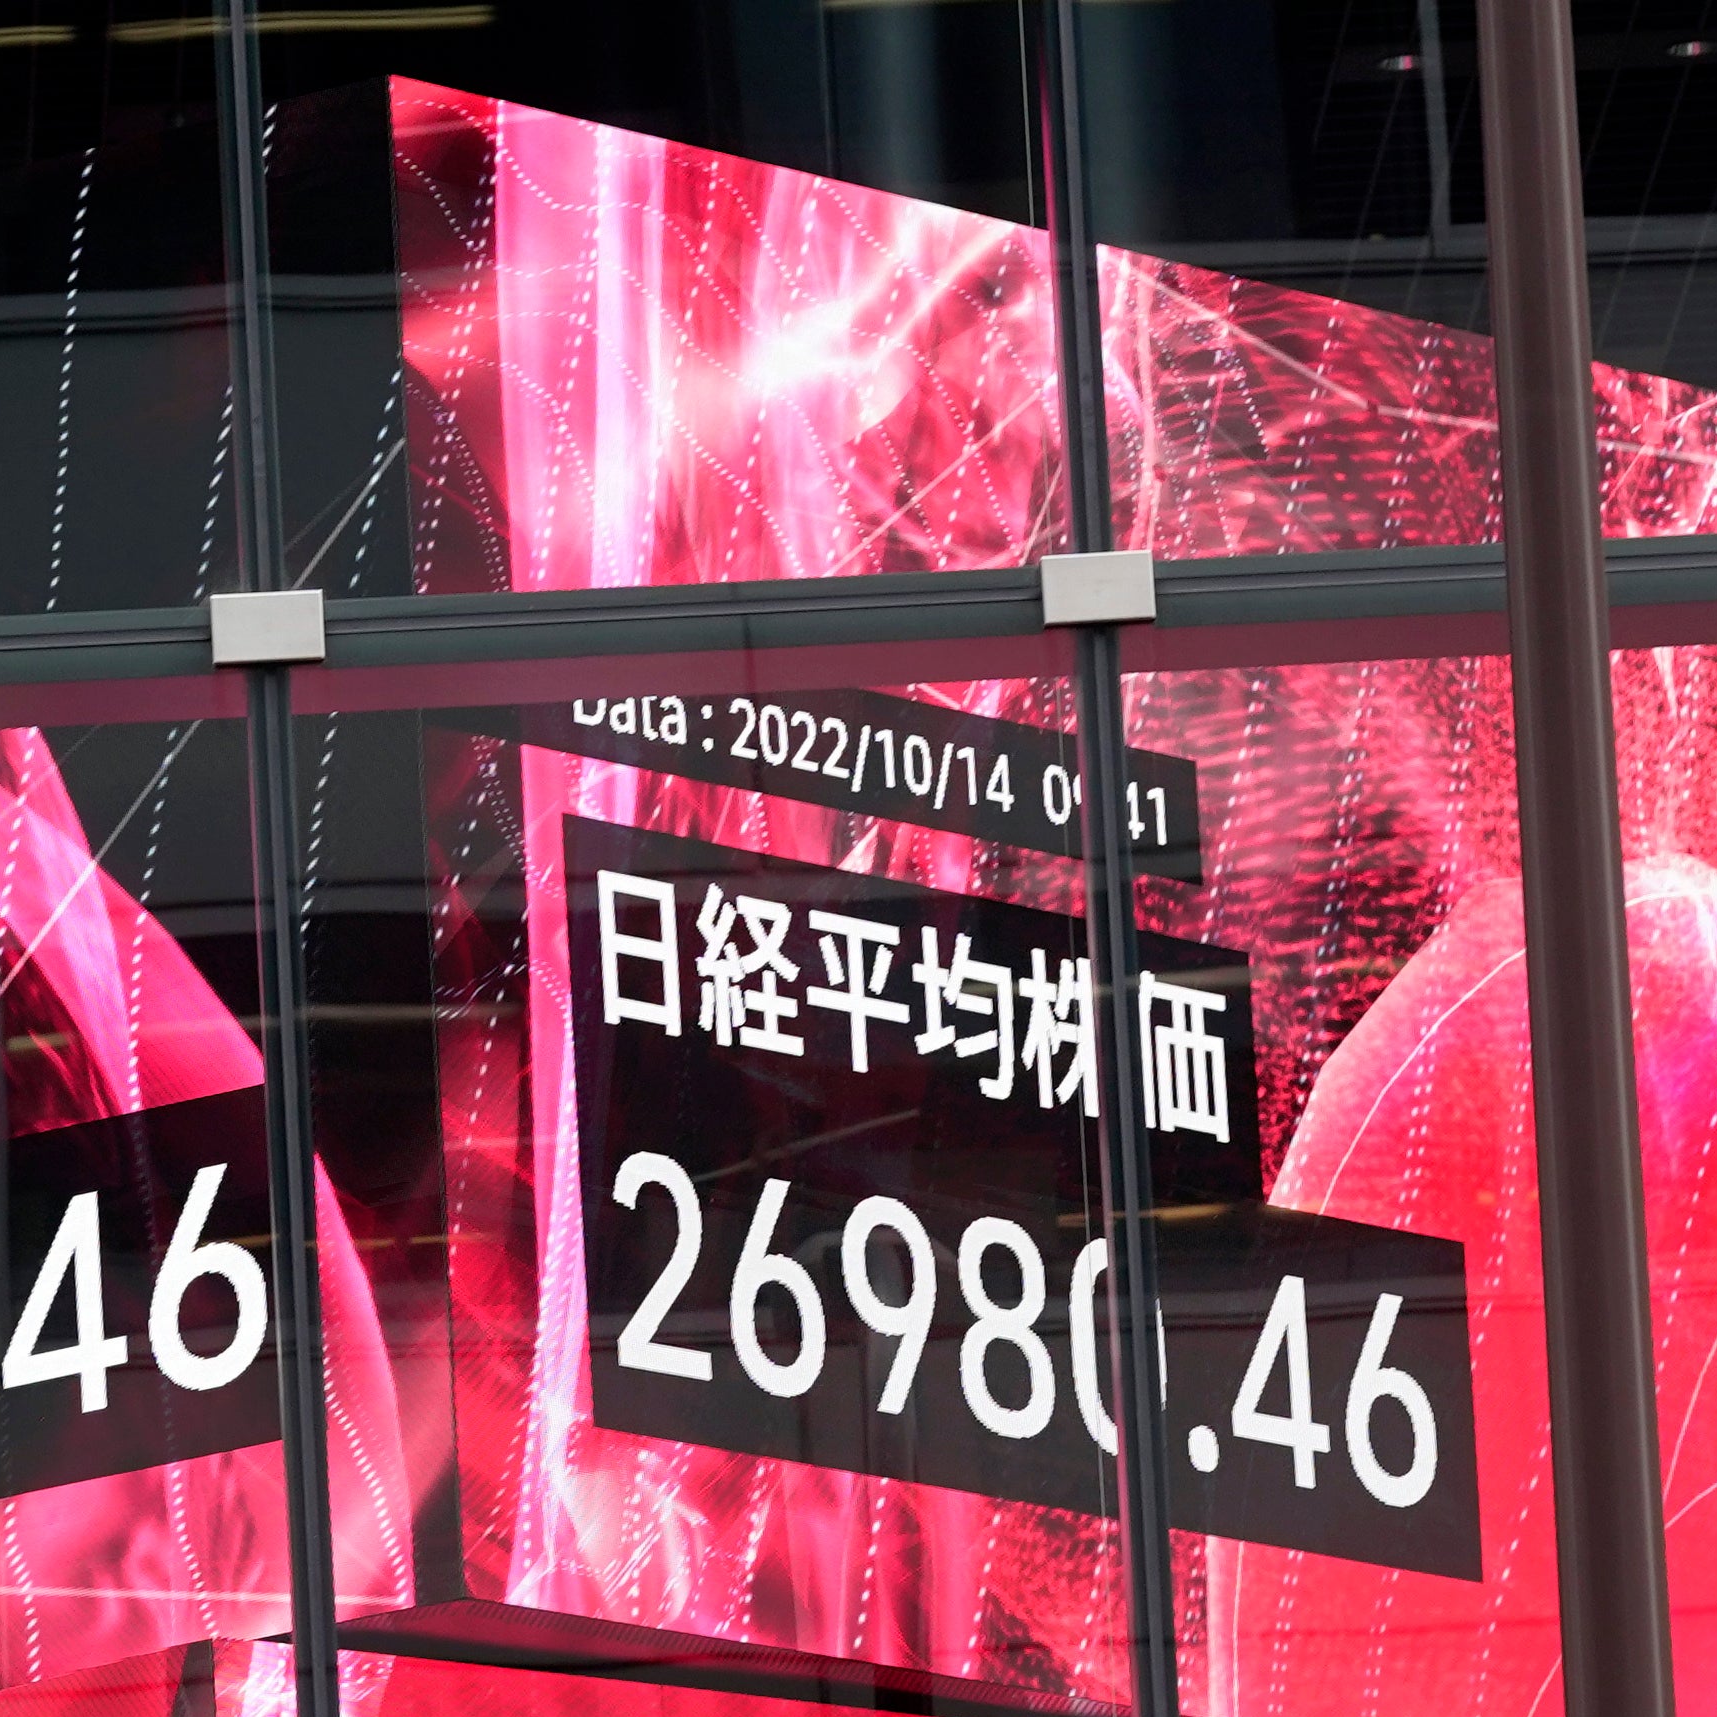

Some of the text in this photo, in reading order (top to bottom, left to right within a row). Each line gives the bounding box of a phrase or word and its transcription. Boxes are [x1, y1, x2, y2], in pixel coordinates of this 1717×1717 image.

[729, 697, 1015, 813] 2022/10/14
[1042, 764, 1167, 846] 041
[596, 868, 1231, 1143] 日経平均株価
